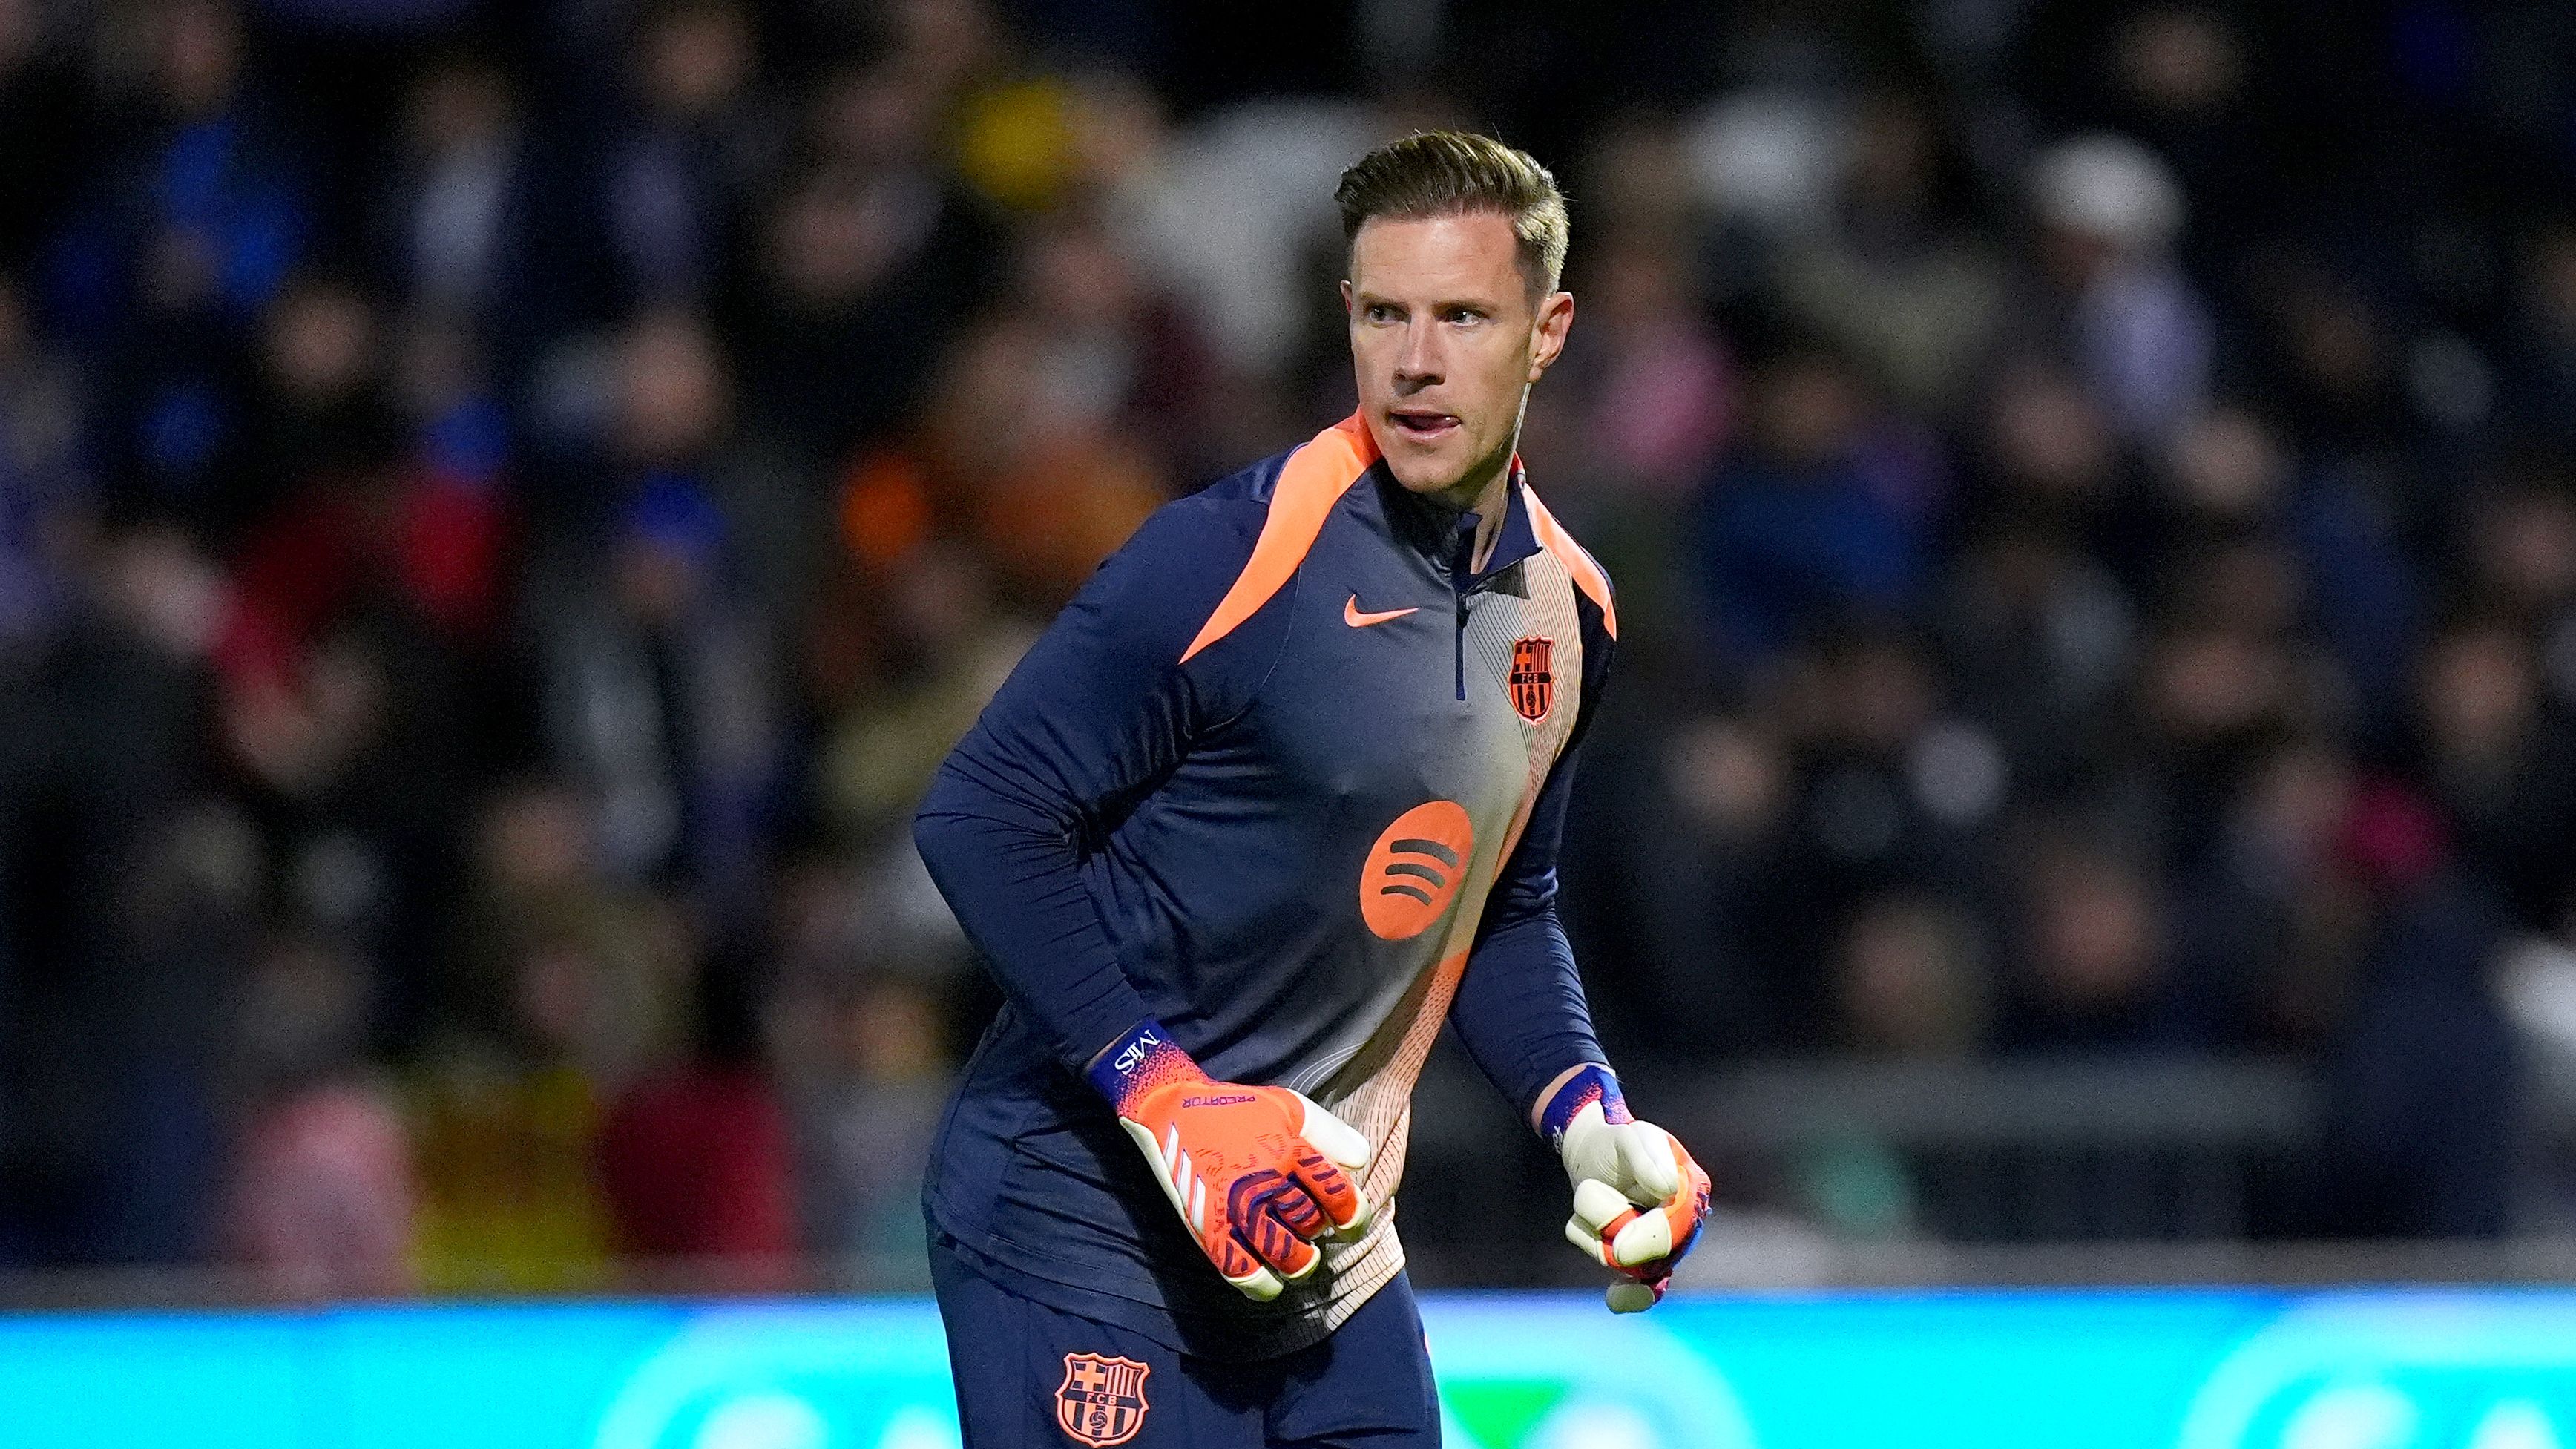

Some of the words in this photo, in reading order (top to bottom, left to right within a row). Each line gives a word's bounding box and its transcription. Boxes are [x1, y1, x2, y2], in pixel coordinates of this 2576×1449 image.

[1521, 673, 1539, 683] FCB
[1182, 1095, 1256, 1108] PREDATOR
[1086, 1392, 1118, 1406] FCB
